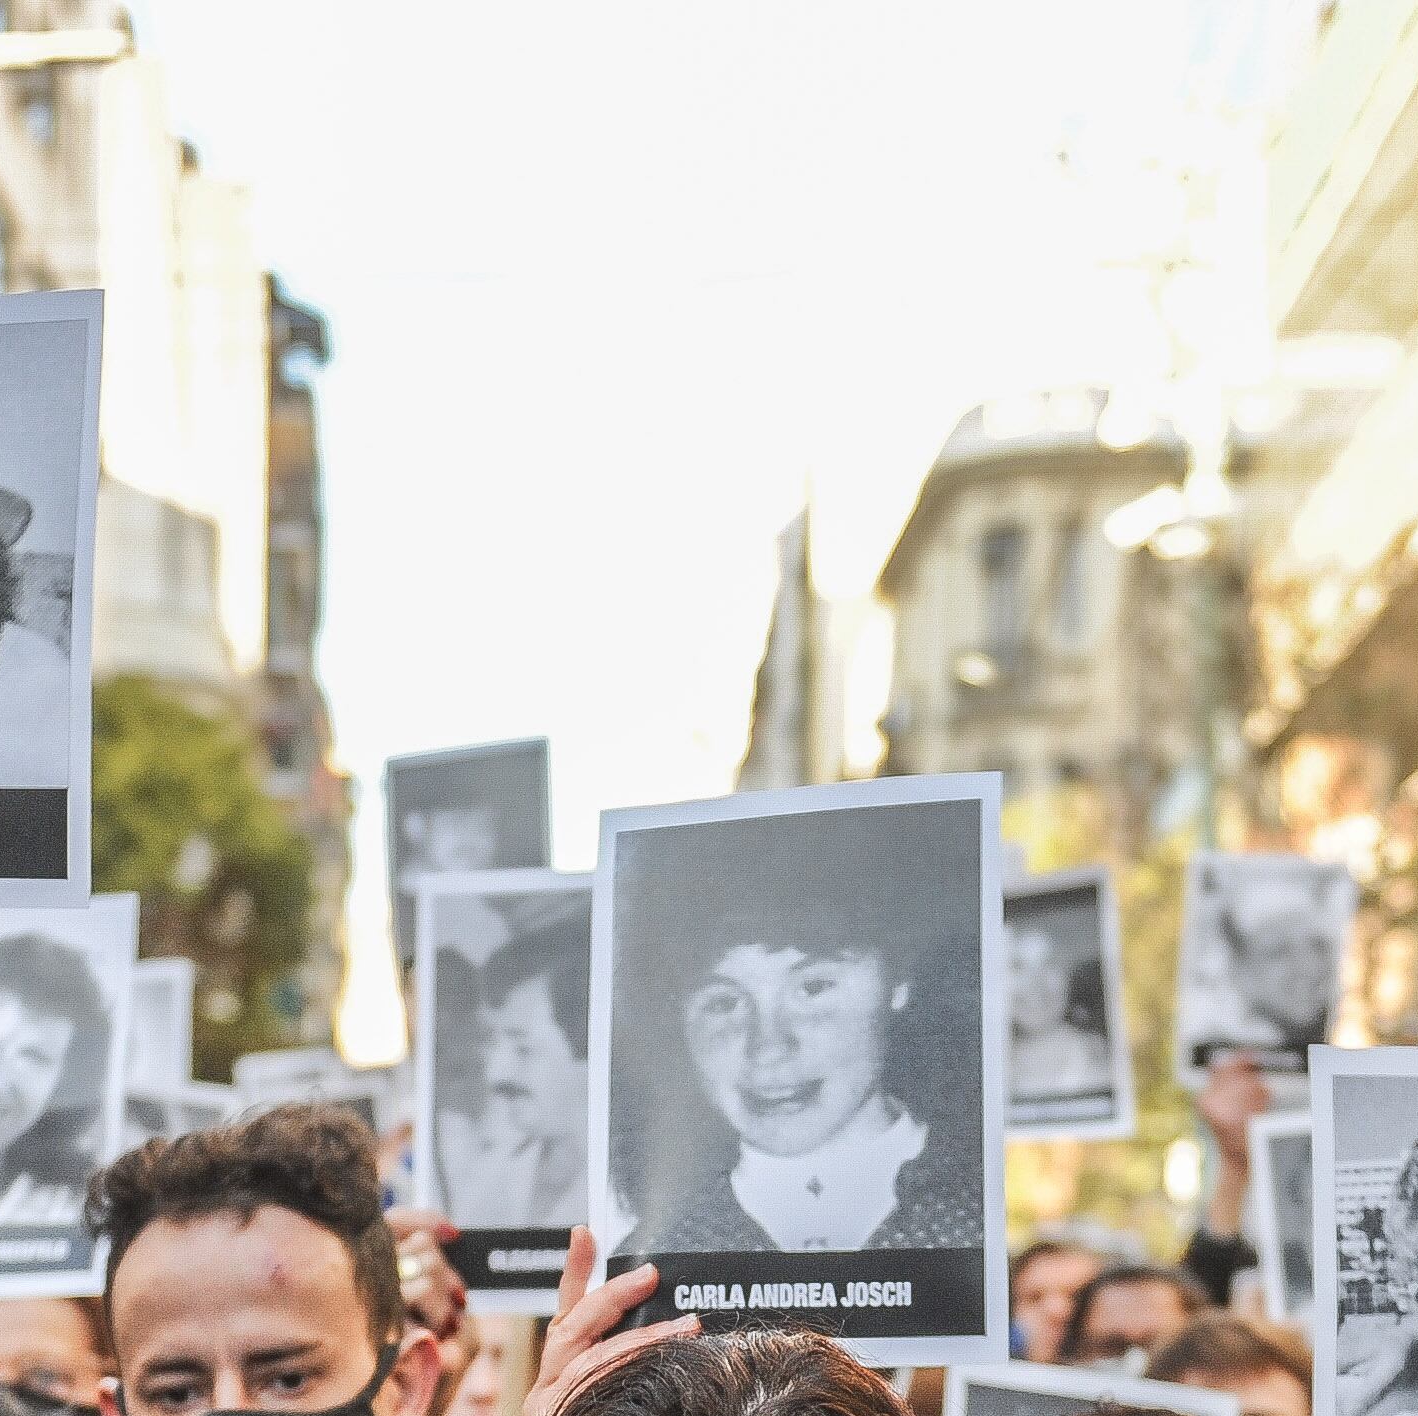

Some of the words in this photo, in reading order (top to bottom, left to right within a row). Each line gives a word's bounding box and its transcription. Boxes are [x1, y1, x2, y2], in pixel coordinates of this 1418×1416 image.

[674, 1284, 746, 1310] CARLA
[748, 1282, 838, 1309] ANDREA
[839, 1281, 913, 1308] JOSCH
